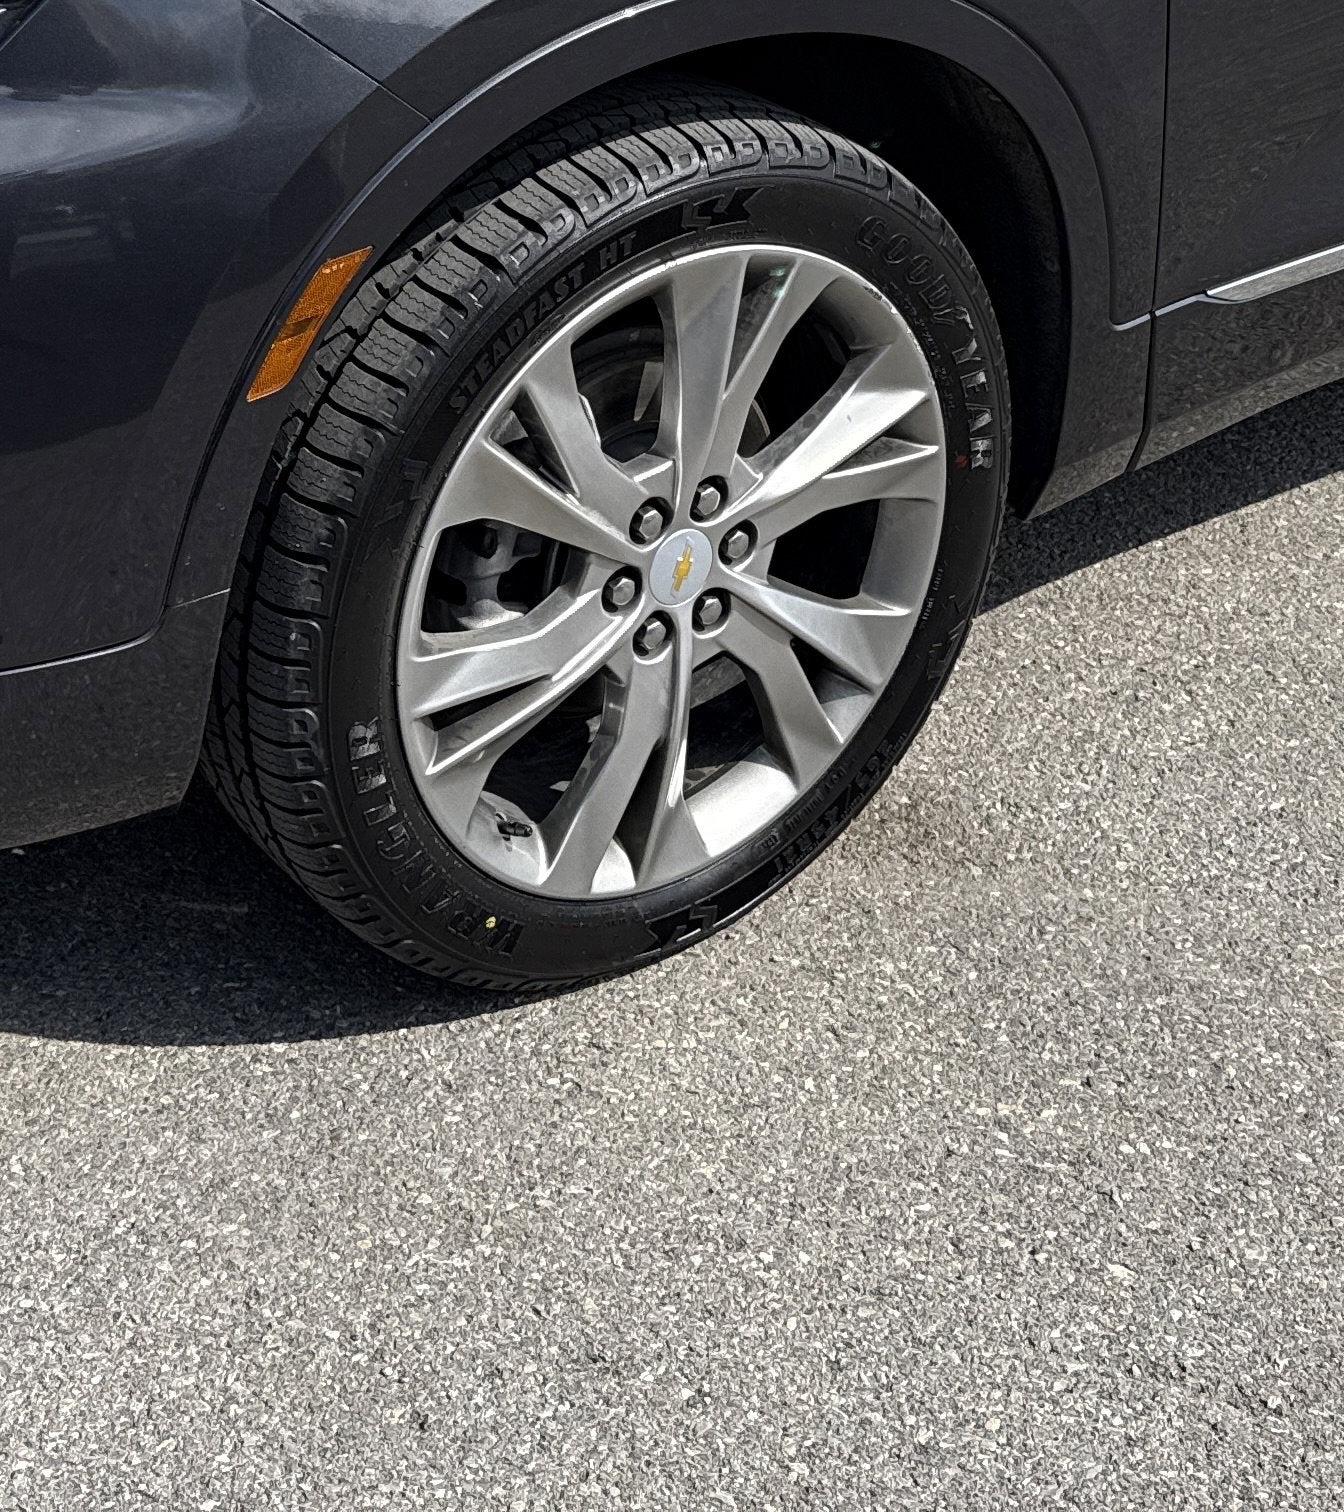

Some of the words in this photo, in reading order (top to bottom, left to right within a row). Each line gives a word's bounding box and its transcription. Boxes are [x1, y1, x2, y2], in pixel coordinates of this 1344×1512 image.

[448, 260, 588, 417] STEADFAST
[597, 229, 639, 272] HT
[855, 212, 995, 472] GOODYEAR
[346, 714, 526, 957] WRANGLER
